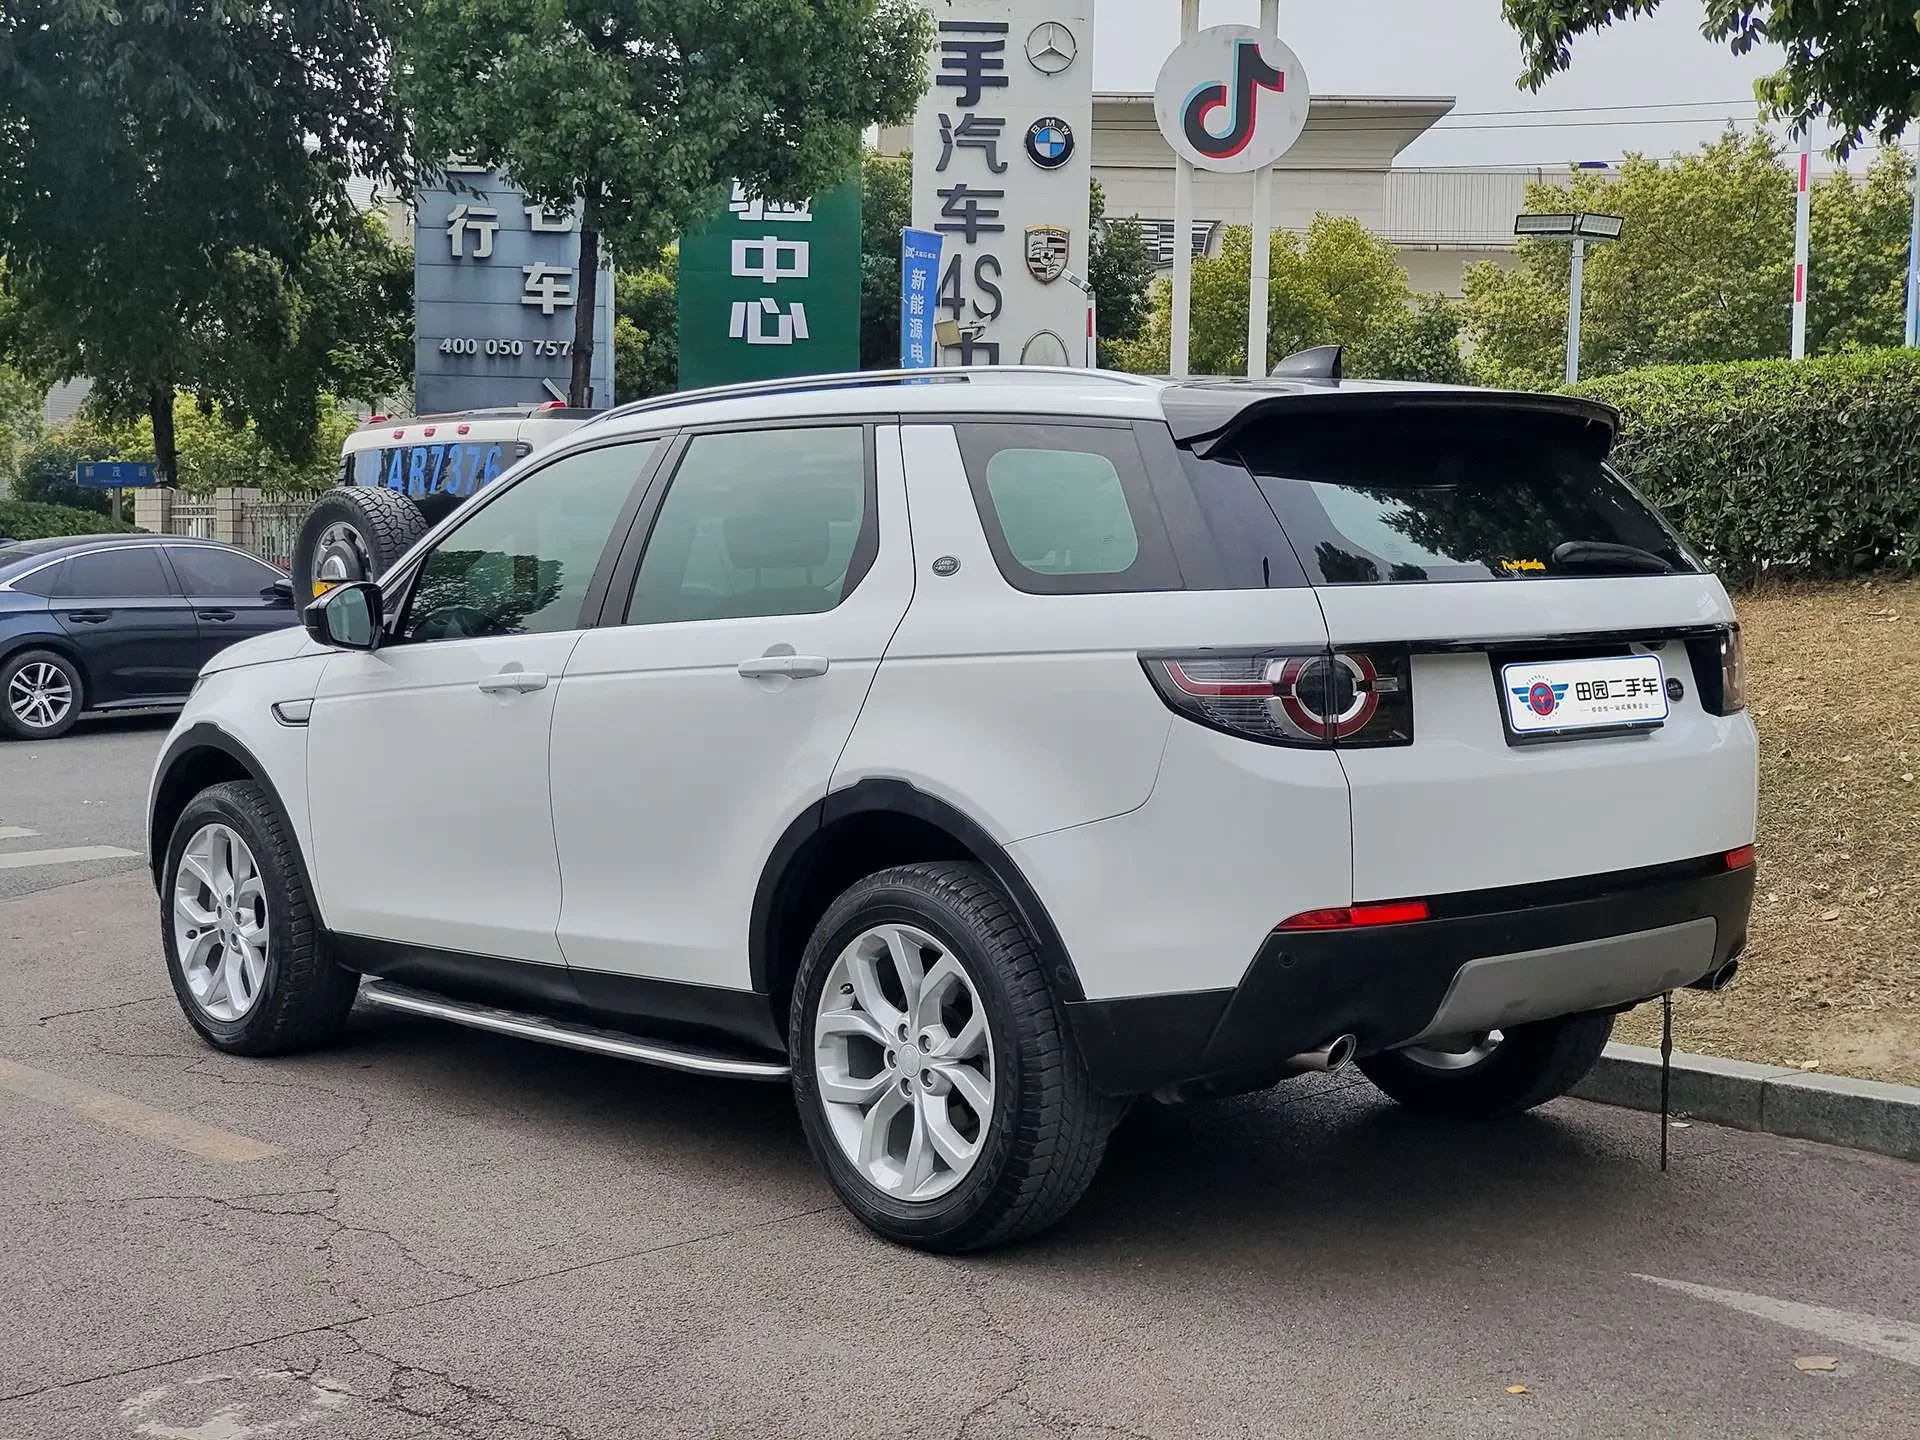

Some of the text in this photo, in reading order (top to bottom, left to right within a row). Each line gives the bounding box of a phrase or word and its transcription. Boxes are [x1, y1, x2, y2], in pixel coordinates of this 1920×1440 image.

[1031, 119, 1070, 135] BMW
[439, 338, 574, 356] 400 050 757
[1575, 677, 1659, 701] 田园二手车
